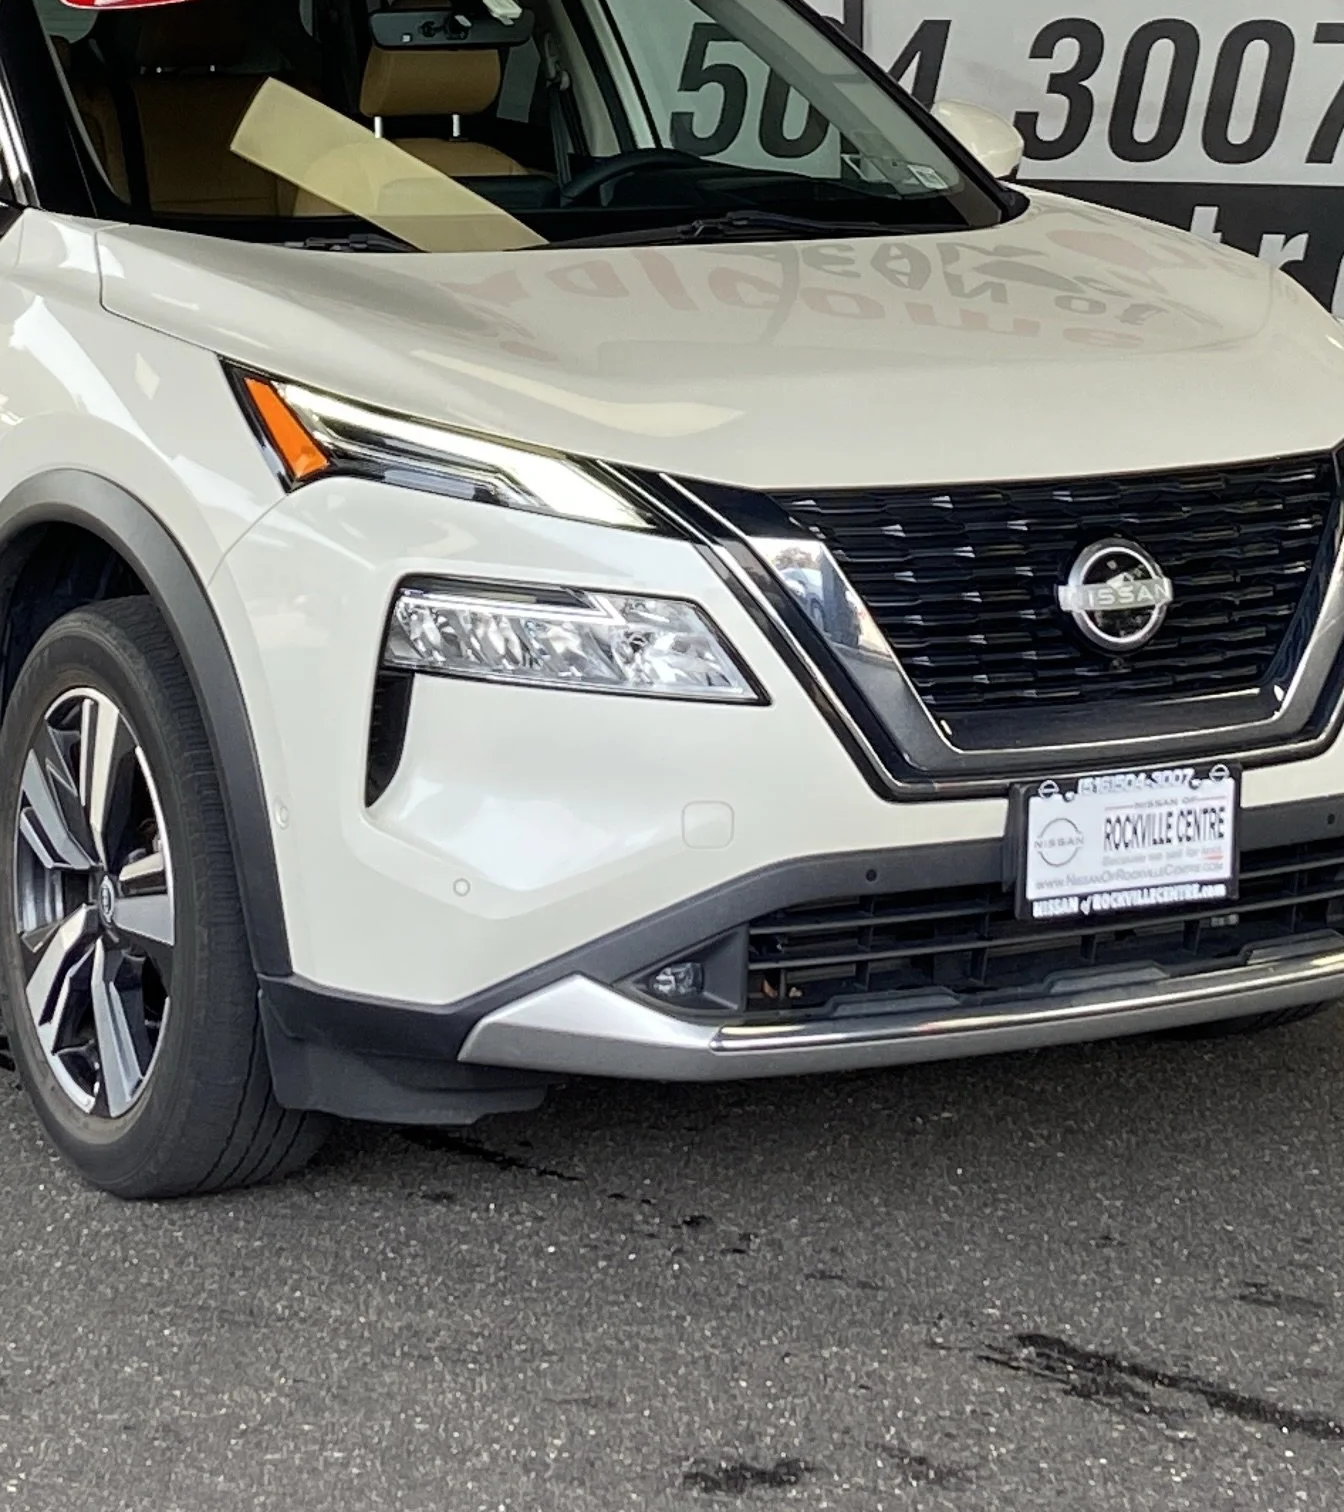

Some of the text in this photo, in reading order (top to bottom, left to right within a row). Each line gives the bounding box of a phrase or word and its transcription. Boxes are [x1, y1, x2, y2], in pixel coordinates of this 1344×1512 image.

[1104, 806, 1226, 851] ROCKVILLE CENTRE
[1034, 835, 1084, 848] NISSAN
[1033, 896, 1078, 918] NISSAN
